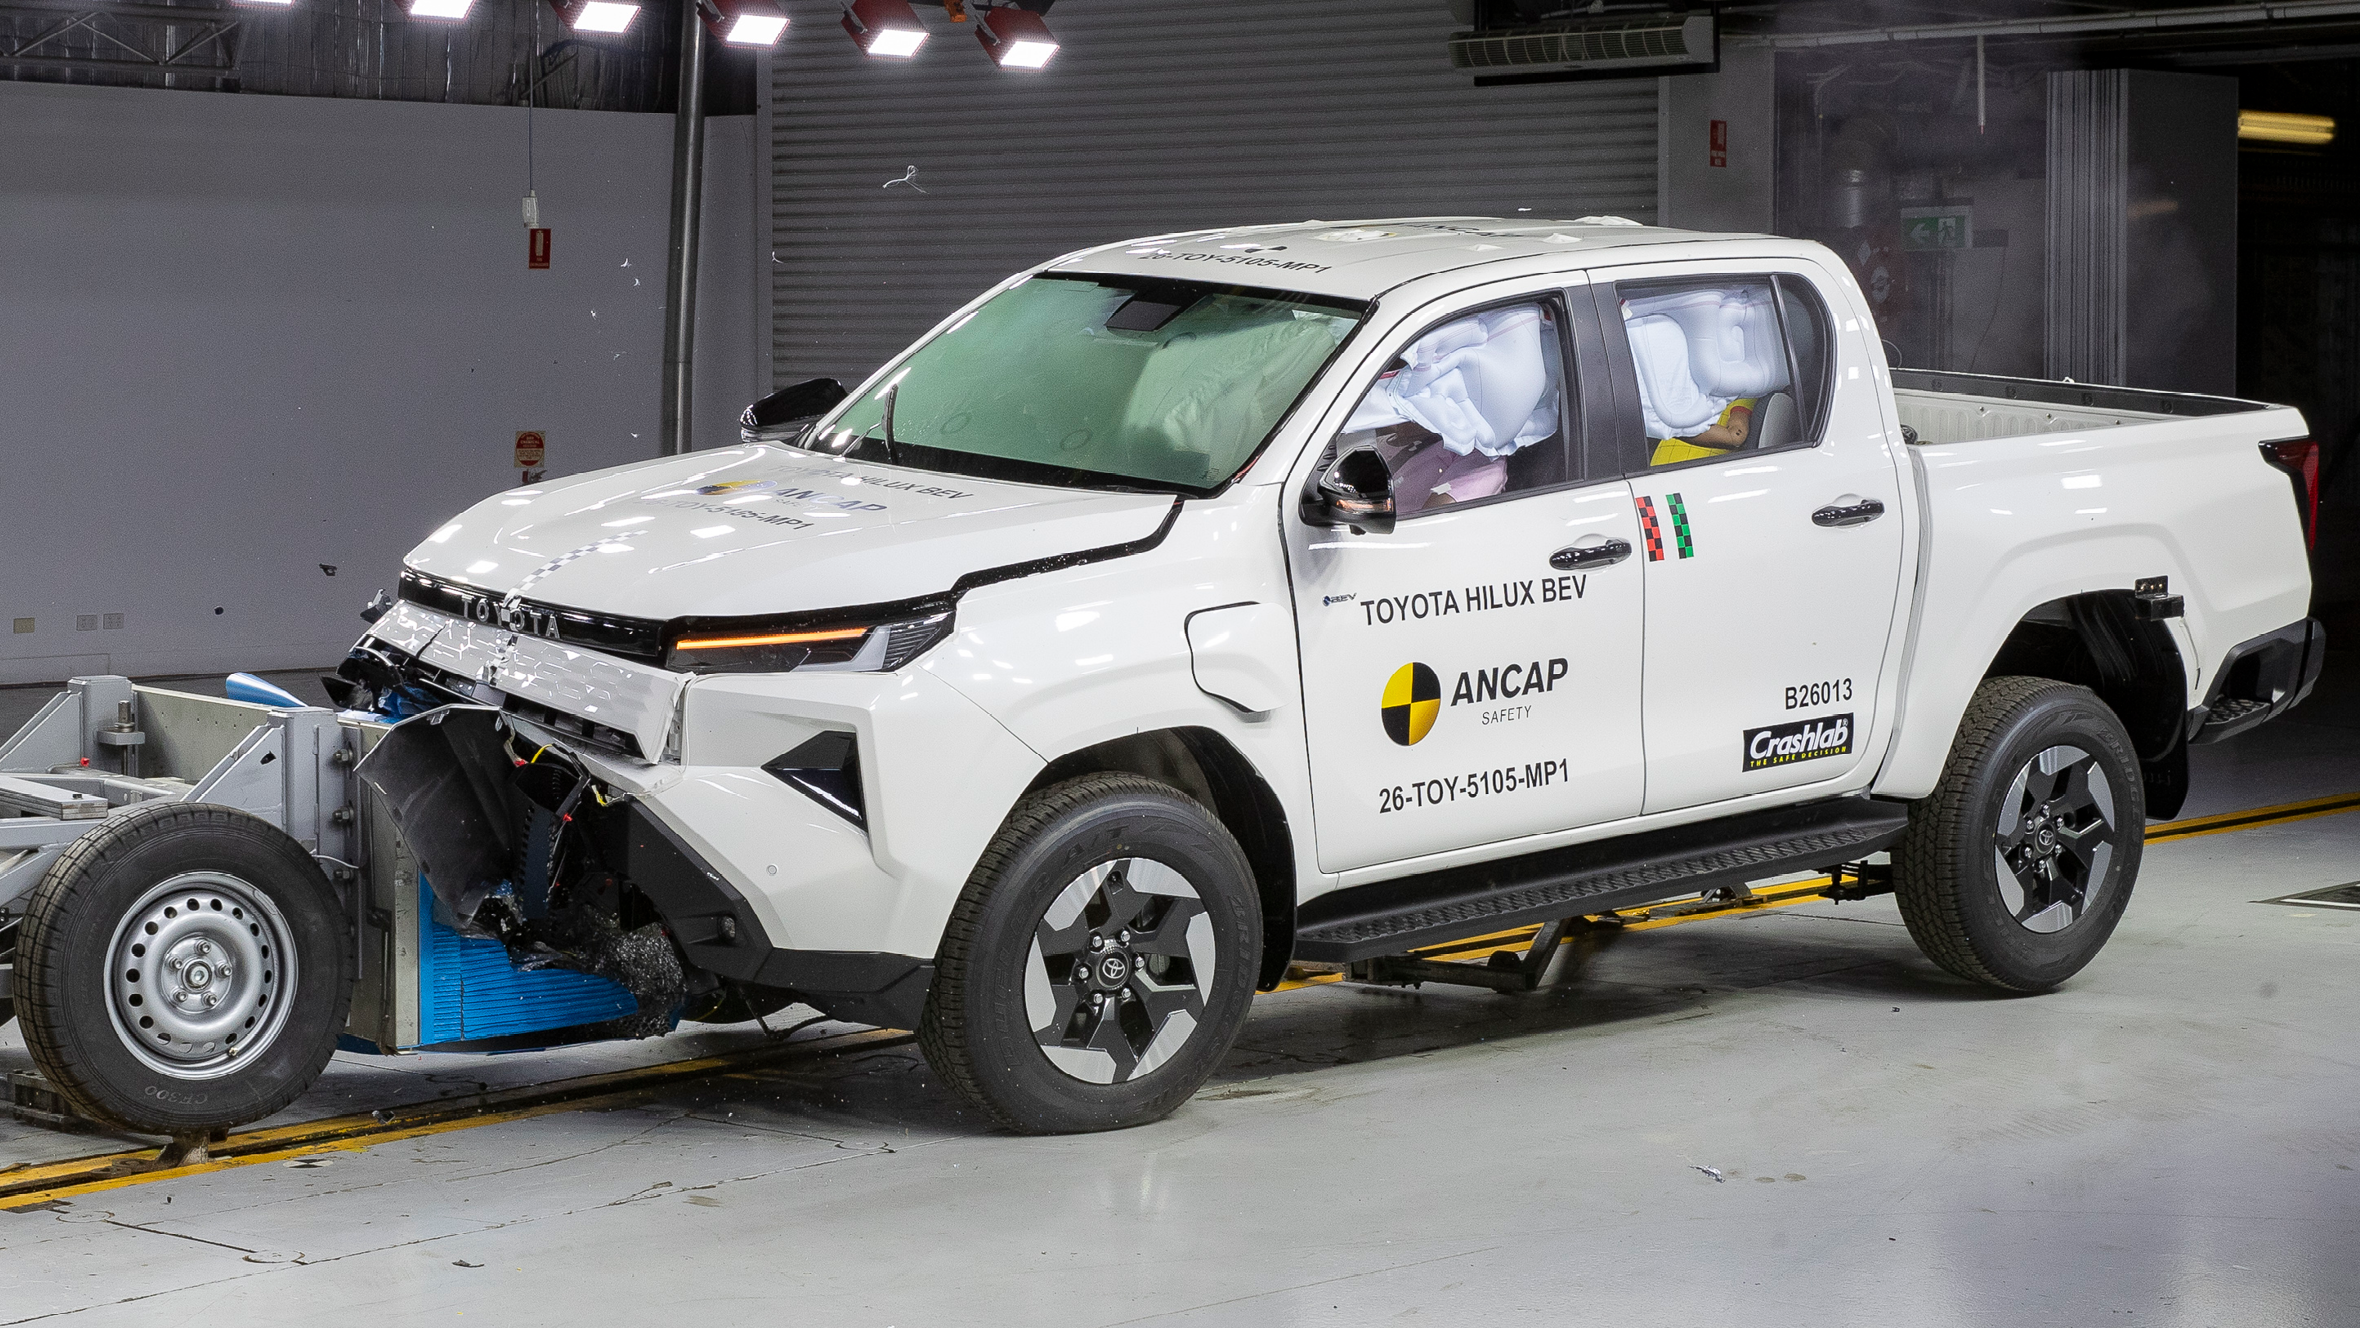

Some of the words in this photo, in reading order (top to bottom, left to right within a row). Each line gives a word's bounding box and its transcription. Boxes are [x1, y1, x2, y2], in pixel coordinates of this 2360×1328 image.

[774, 488, 888, 512] ANCAP
[860, 475, 926, 492] HILUX
[917, 486, 974, 500] BEV
[1360, 590, 1460, 626] TOYOTA
[1465, 580, 1535, 612] HILUX
[1541, 574, 1587, 603] BEV
[461, 594, 560, 638] TOYOTA
[1450, 657, 1569, 707] ANCAP
[1785, 677, 1852, 710] B26013
[1481, 705, 1532, 725] SAFETY
[1750, 758, 1767, 768] THE
[1773, 753, 1796, 764] SAFE
[1801, 746, 1847, 759] DECISION
[1379, 757, 1569, 814] 26-TOY-5105-MP1
[144, 1085, 209, 1105] CF300
